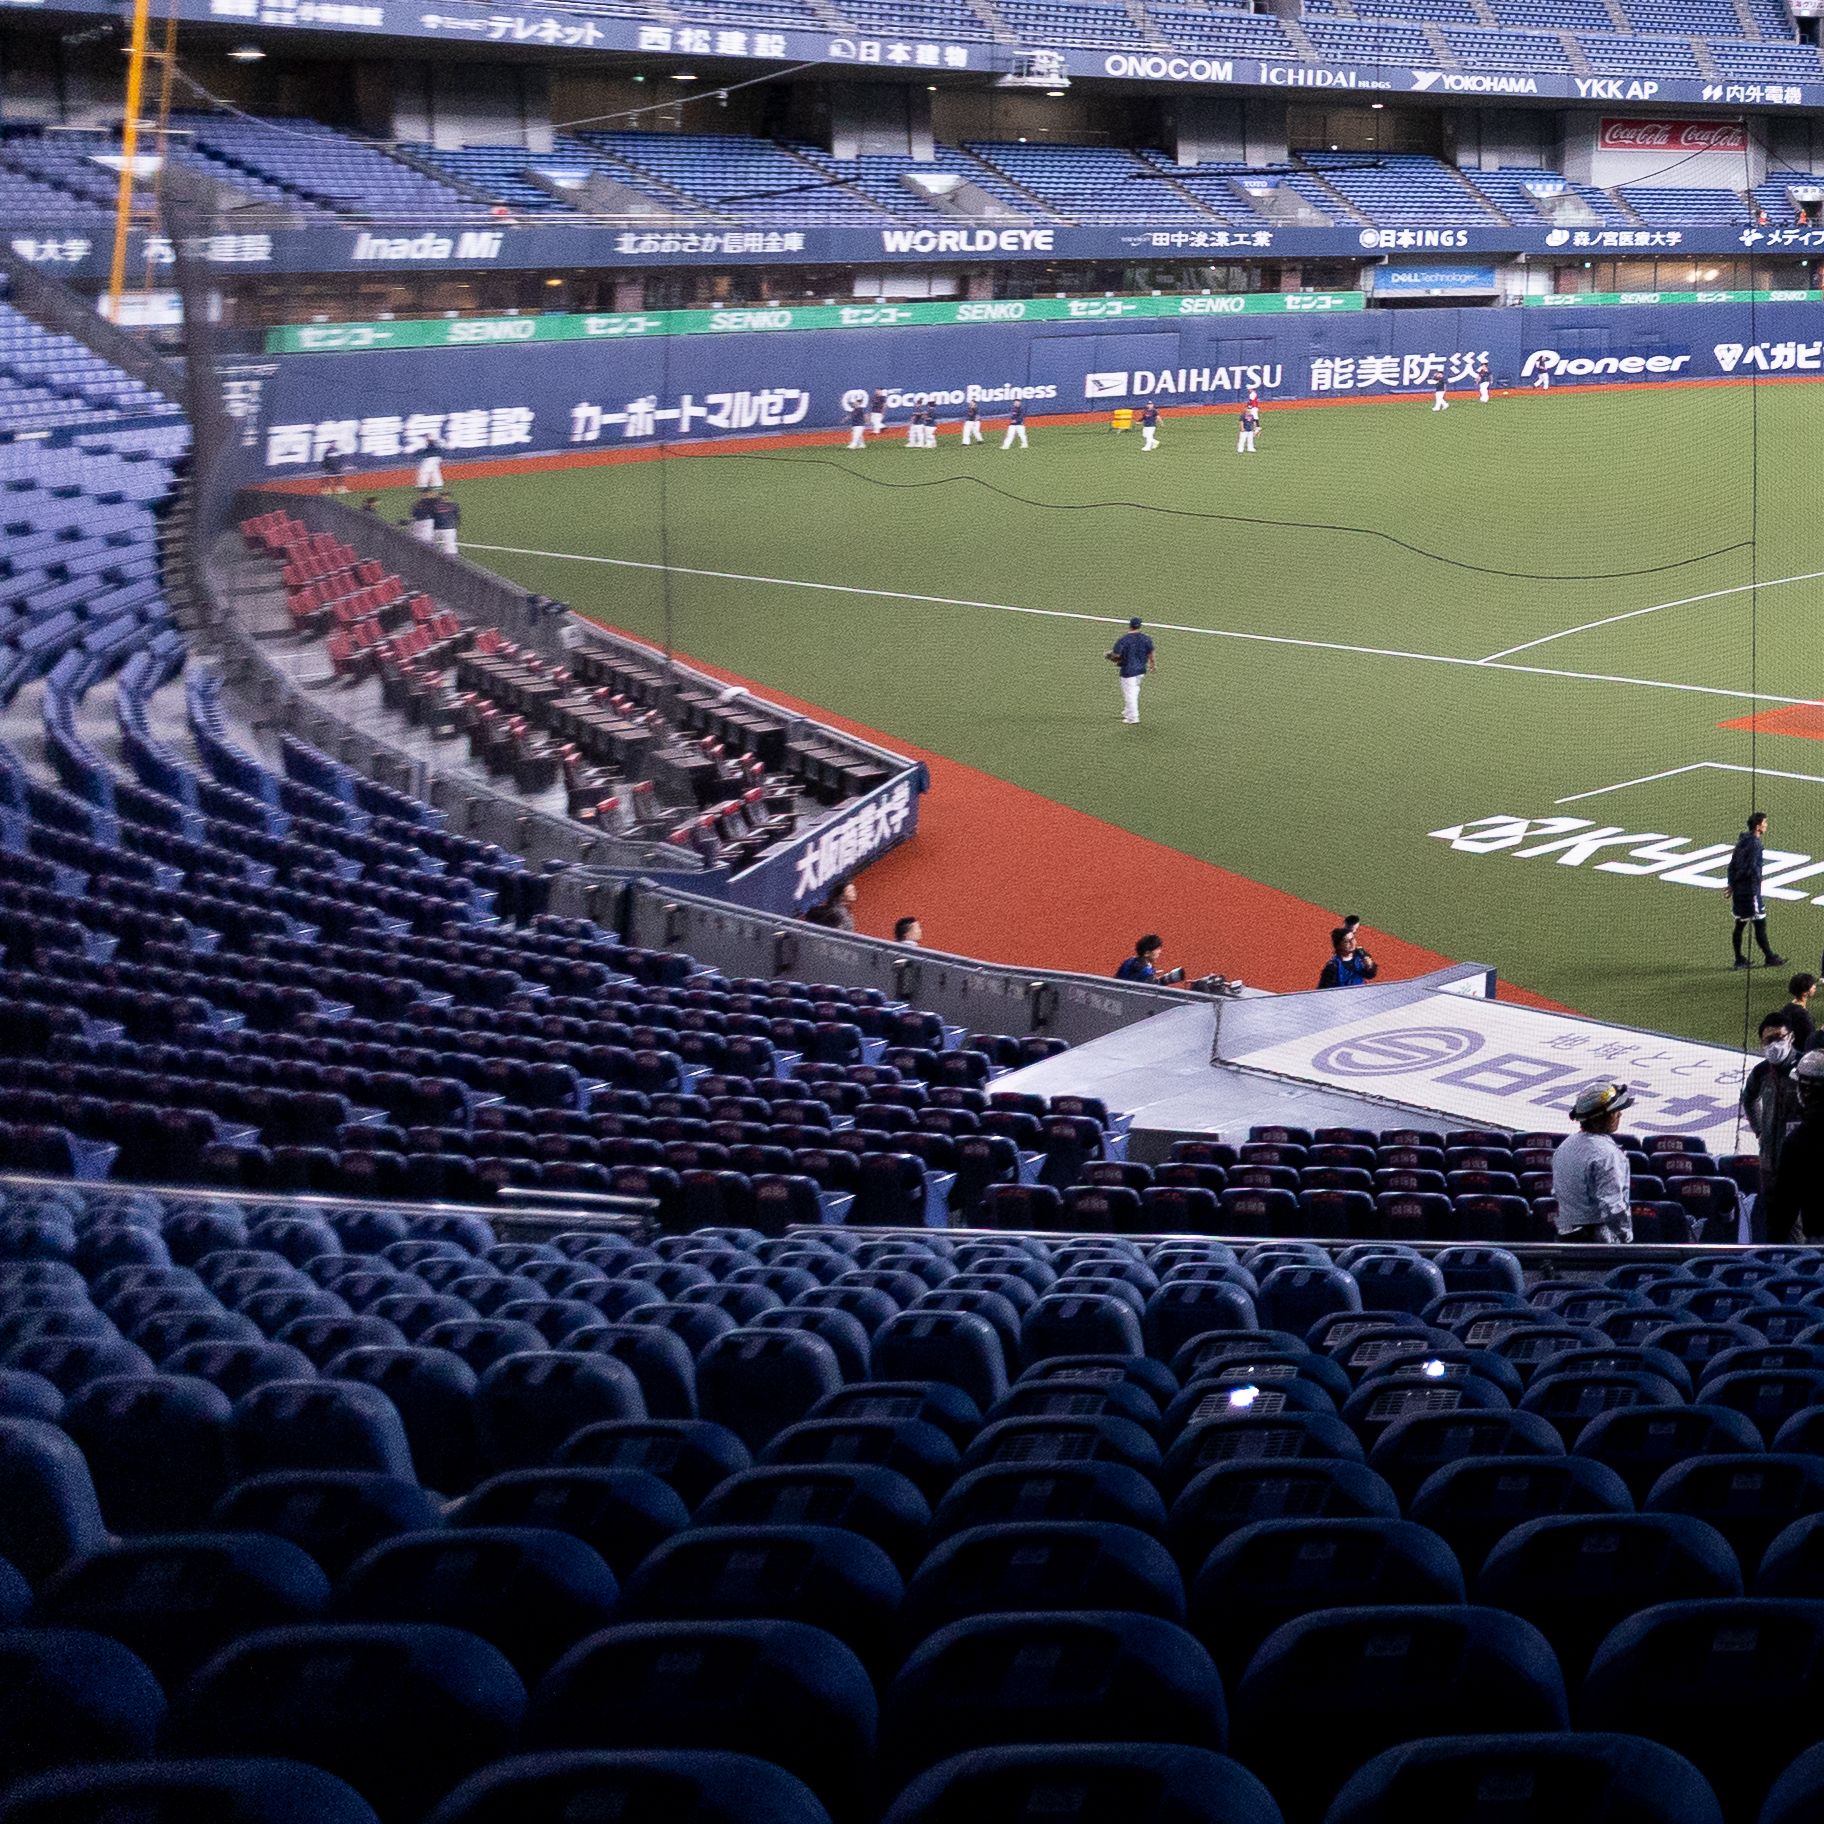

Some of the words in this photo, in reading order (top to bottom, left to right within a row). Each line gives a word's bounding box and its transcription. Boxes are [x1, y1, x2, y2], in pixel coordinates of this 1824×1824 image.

[639, 25, 787, 58] 西松建設
[859, 39, 969, 68] 日本建物
[1105, 54, 1233, 81] ONOCOM
[1260, 63, 1356, 89] ICHIDAI
[1440, 74, 1538, 94] YOKOHAMA
[1574, 77, 1626, 99] YKK
[1629, 78, 1660, 100] AP
[1725, 85, 1802, 105] 内外電機
[352, 232, 453, 260] Inada
[613, 231, 806, 255] 北おおさか信用金庫
[1379, 229, 1468, 248] 日本INGS
[1573, 230, 1682, 247] 森ノ宮医療大学
[1391, 272, 1420, 283] DELL
[1178, 297, 1244, 313] SENKO
[1284, 294, 1344, 309] センコー
[1543, 294, 1583, 305] センコー
[1619, 292, 1660, 304] SENKO
[1697, 291, 1734, 302] センコー
[1768, 290, 1807, 302] SENKO
[839, 308, 912, 324] センコー
[956, 303, 1026, 320] SENKO
[1067, 299, 1136, 316] センコー
[584, 316, 662, 334] センコー
[709, 311, 792, 329] SENKO
[301, 329, 394, 347] センコー
[447, 320, 535, 341] SENKO
[1310, 350, 1490, 391] 能美防災
[1521, 349, 1692, 377] Pioneer
[1132, 363, 1283, 397] DAIHATSU
[966, 382, 1057, 404] Business
[571, 388, 810, 442] カーポートマルゼン
[793, 779, 910, 900] 大阪商業大学
